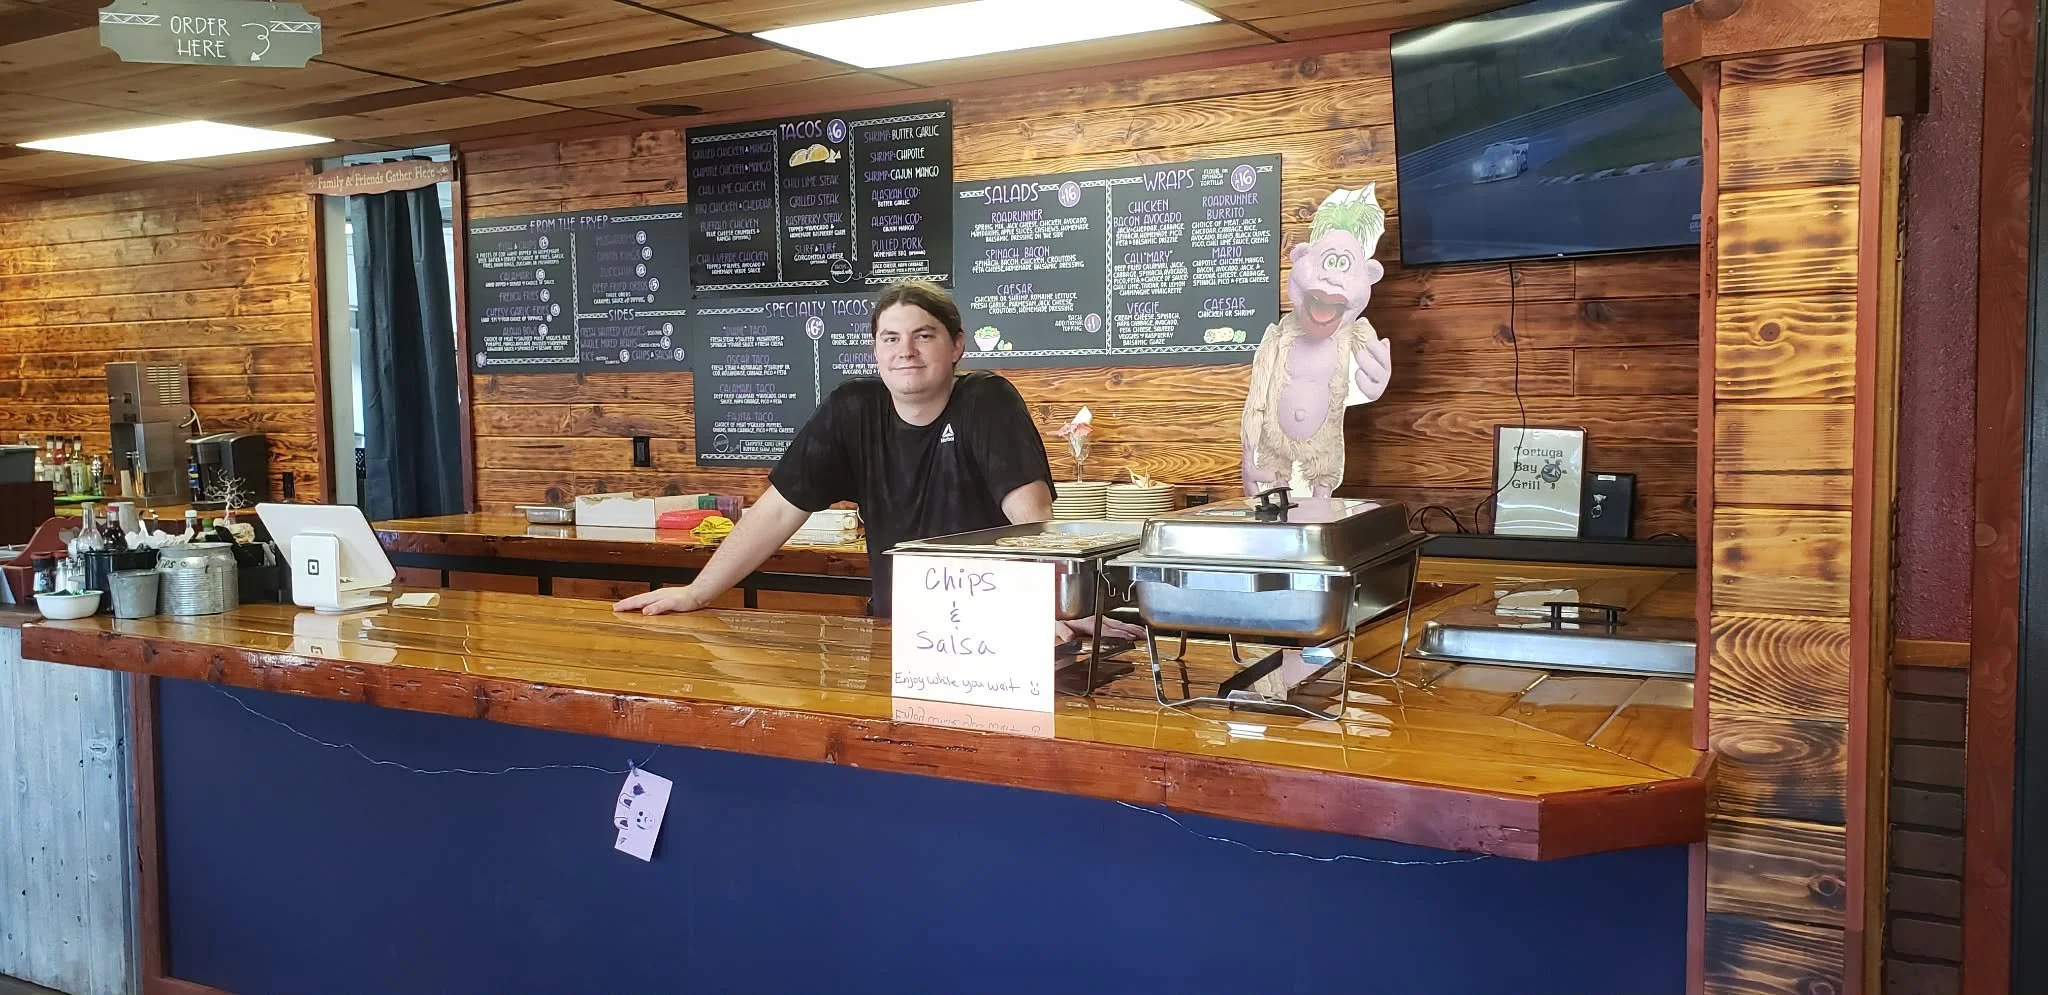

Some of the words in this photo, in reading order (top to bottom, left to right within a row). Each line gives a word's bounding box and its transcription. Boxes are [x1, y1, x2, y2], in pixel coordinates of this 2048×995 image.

[170, 16, 230, 36] ORDER
[177, 39, 226, 58] HERE
[780, 120, 821, 140] TACOS
[892, 128, 914, 140] BUTTER
[916, 125, 939, 138] GARLIC
[717, 147, 744, 158] CHICKEN
[750, 143, 771, 154] MANGO
[896, 148, 925, 160] CHIPOTLE
[749, 161, 771, 172] MANGO
[890, 168, 913, 181] CAJUN
[916, 165, 939, 178] MANGO
[318, 175, 344, 192] Family
[345, 178, 352, 186] &
[355, 172, 383, 186] Friends
[386, 170, 412, 182] Gather
[414, 166, 435, 178] Here
[802, 176, 818, 188] LIME
[820, 175, 839, 186] STEAK
[1144, 169, 1195, 192] WRAPS
[718, 182, 734, 193] LIME
[735, 180, 766, 192] CHICKEN
[818, 193, 840, 206] STEAK
[872, 189, 902, 201] ALASKAN
[904, 187, 920, 198] COD:
[984, 183, 1038, 204] SALADS
[710, 200, 738, 213] CHICKEN
[1128, 199, 1169, 214] CHICKEN
[1202, 193, 1258, 208] ROADRUNNER
[822, 212, 843, 224] STEAK
[872, 215, 902, 227] ALASKAN
[904, 213, 922, 225] COD:
[992, 209, 1042, 223] ROADRUNNER
[1114, 216, 1140, 227] BACON
[1144, 212, 1182, 224] AVOCADO
[1207, 207, 1244, 220] BURRITO
[530, 219, 555, 233] FROM
[558, 217, 575, 231] THE
[730, 219, 759, 230] CHICKEN
[794, 244, 813, 254] SURF
[819, 243, 836, 254] TURF
[872, 240, 898, 251] PULLED
[902, 237, 923, 249] PORK
[739, 252, 768, 261] CHICKEN
[985, 248, 1019, 260] SPINACH
[1025, 246, 1050, 258] BACON
[1212, 246, 1242, 259] MARIO
[997, 283, 1033, 296] CAESAR
[765, 301, 826, 318] SPECIALTY
[832, 300, 868, 315] TACOS
[1127, 302, 1159, 314] VEGGIE
[1204, 297, 1246, 311] CAESAR
[609, 309, 634, 320] SIDES
[749, 325, 768, 336] TACO
[727, 355, 750, 364] OSCAR
[752, 355, 769, 364] TACO
[839, 353, 876, 363] CALIFORN
[720, 384, 752, 393] CALAMARI
[756, 384, 775, 393] TACO
[754, 412, 774, 422] TACO
[1513, 446, 1563, 458] Tortuga
[1514, 461, 1537, 473] Bay
[1512, 479, 1540, 490] Grill
[926, 567, 996, 596] Chips
[917, 630, 996, 655] Salsa
[895, 671, 925, 690] Enjoy
[926, 673, 960, 688] while
[962, 680, 985, 693] you
[988, 678, 1021, 692] wait
